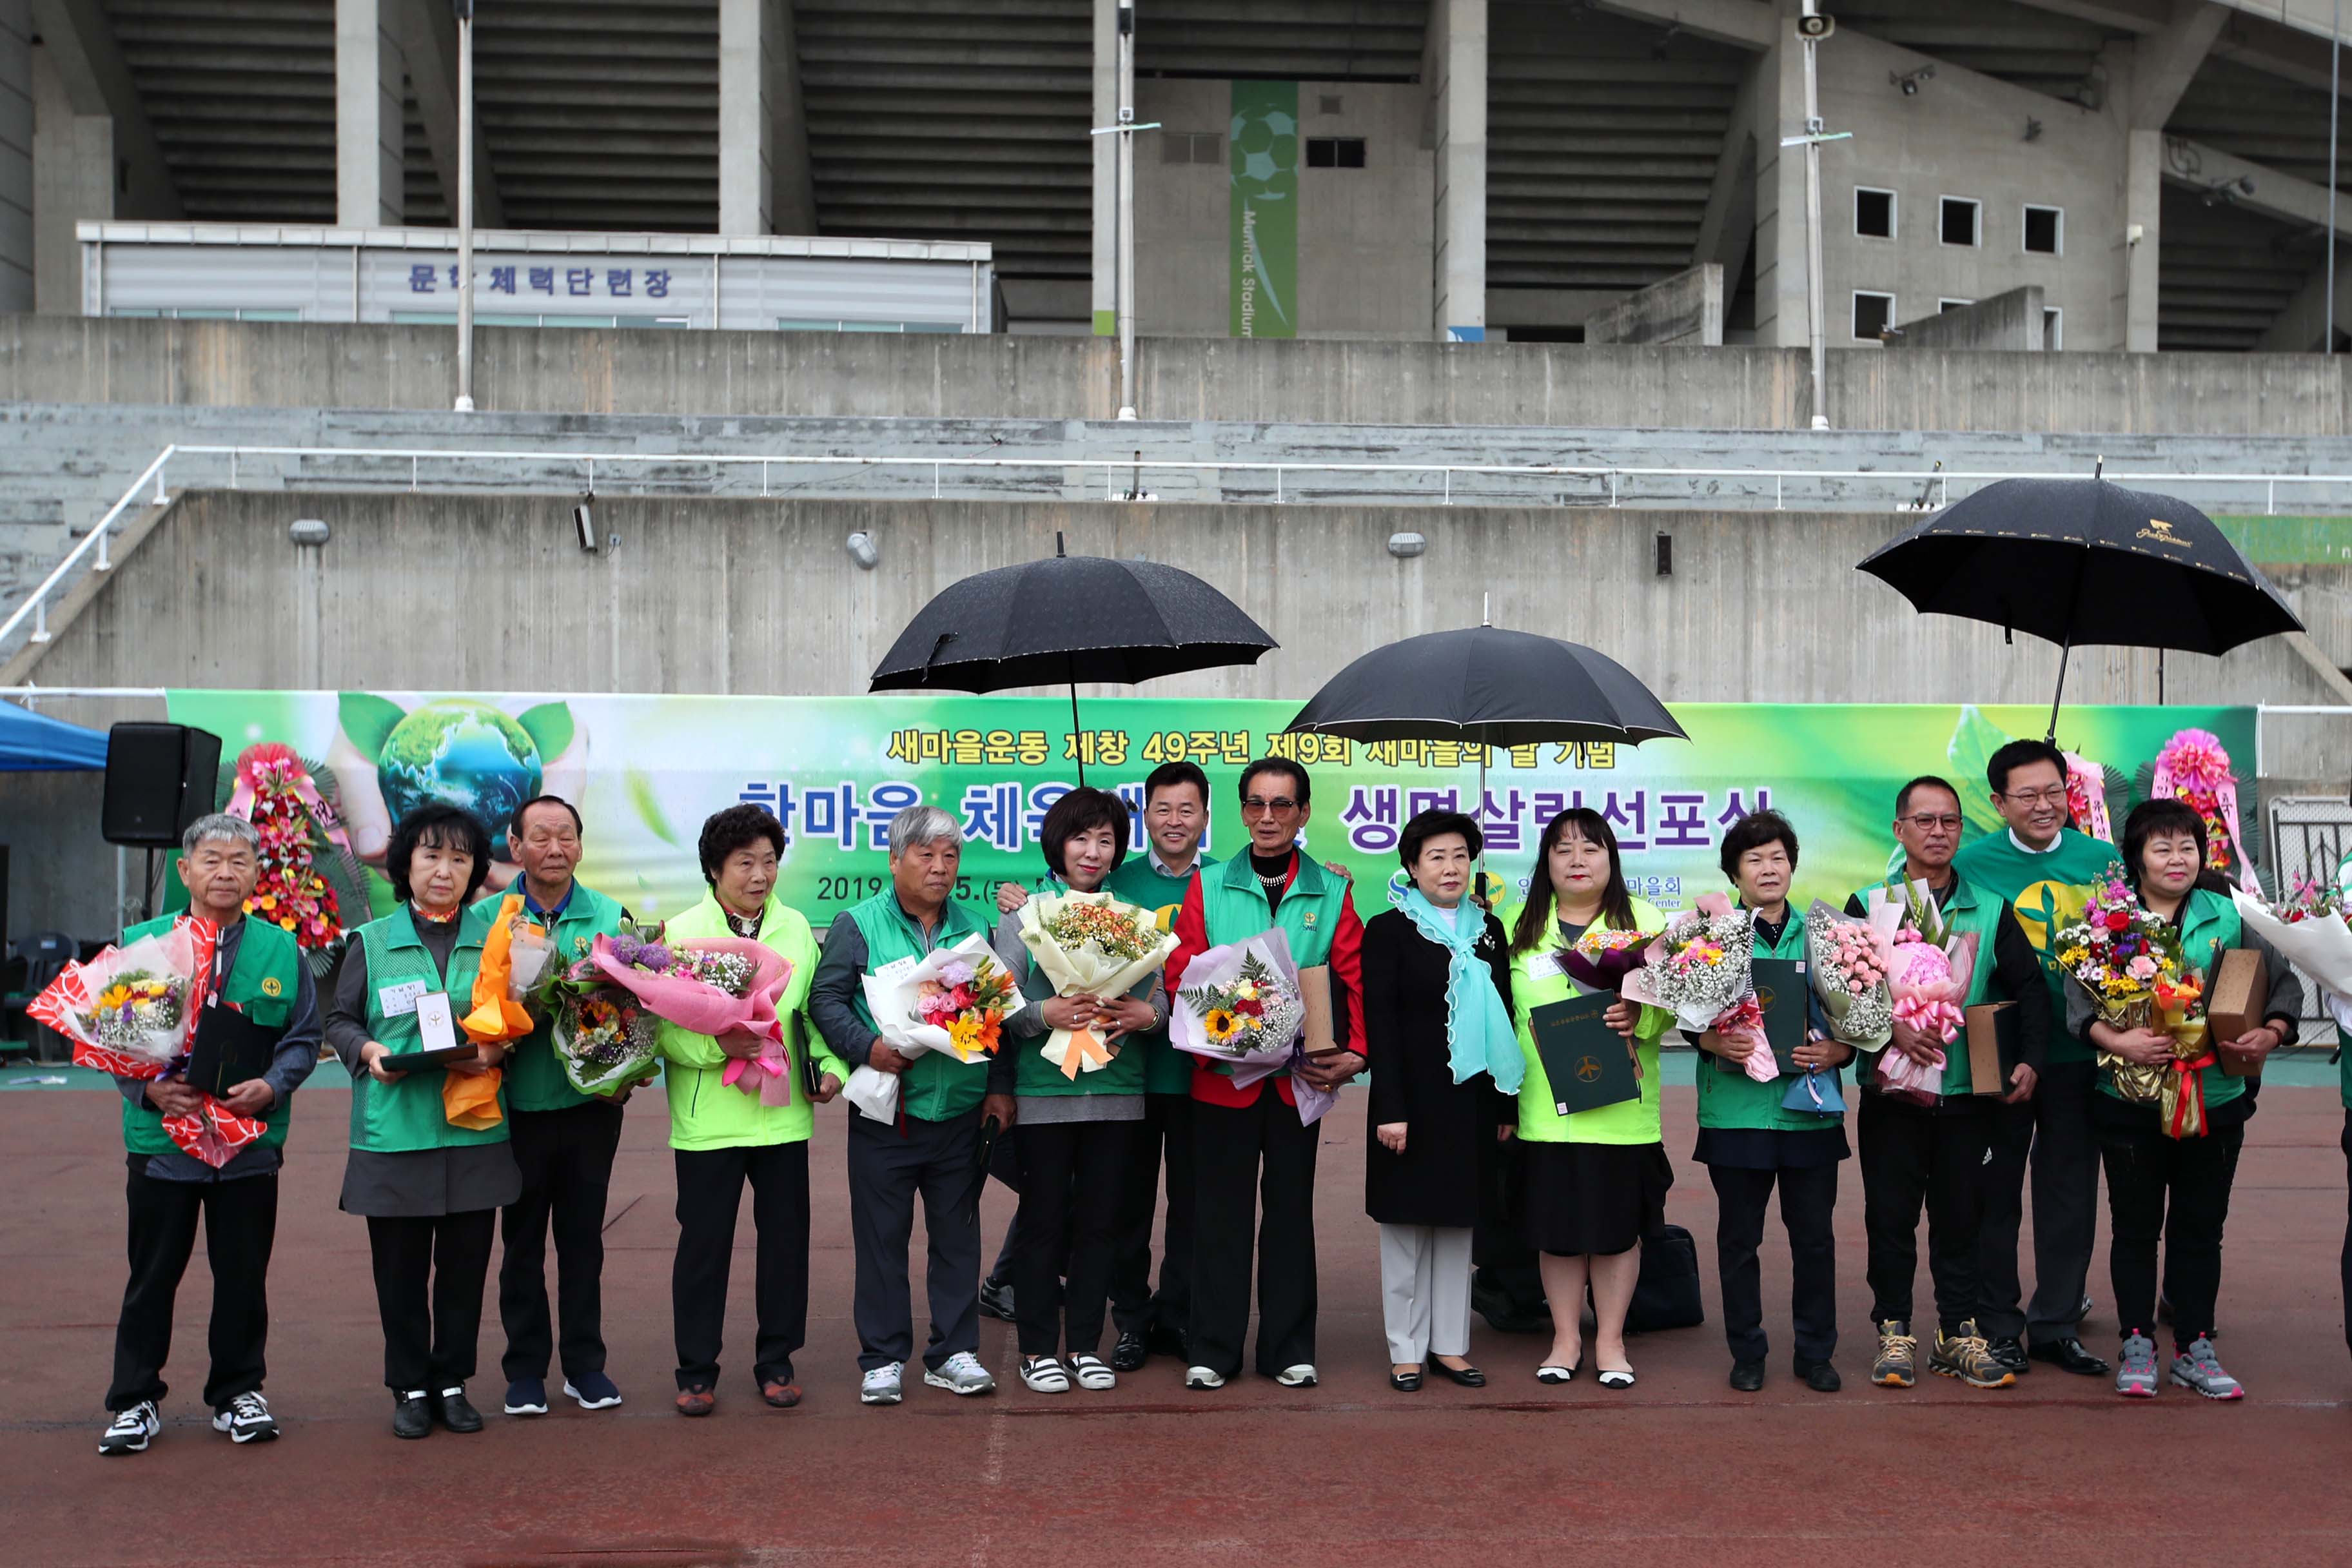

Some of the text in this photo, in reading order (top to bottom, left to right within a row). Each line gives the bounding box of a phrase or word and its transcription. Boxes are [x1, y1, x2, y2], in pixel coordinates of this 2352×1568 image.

[887, 729, 1050, 765] 새마을운동
[1063, 730, 1129, 765] 제창
[1142, 730, 1250, 765] 49주년
[1266, 732, 1351, 766] 제9회
[1366, 740, 1493, 769] 새마을의
